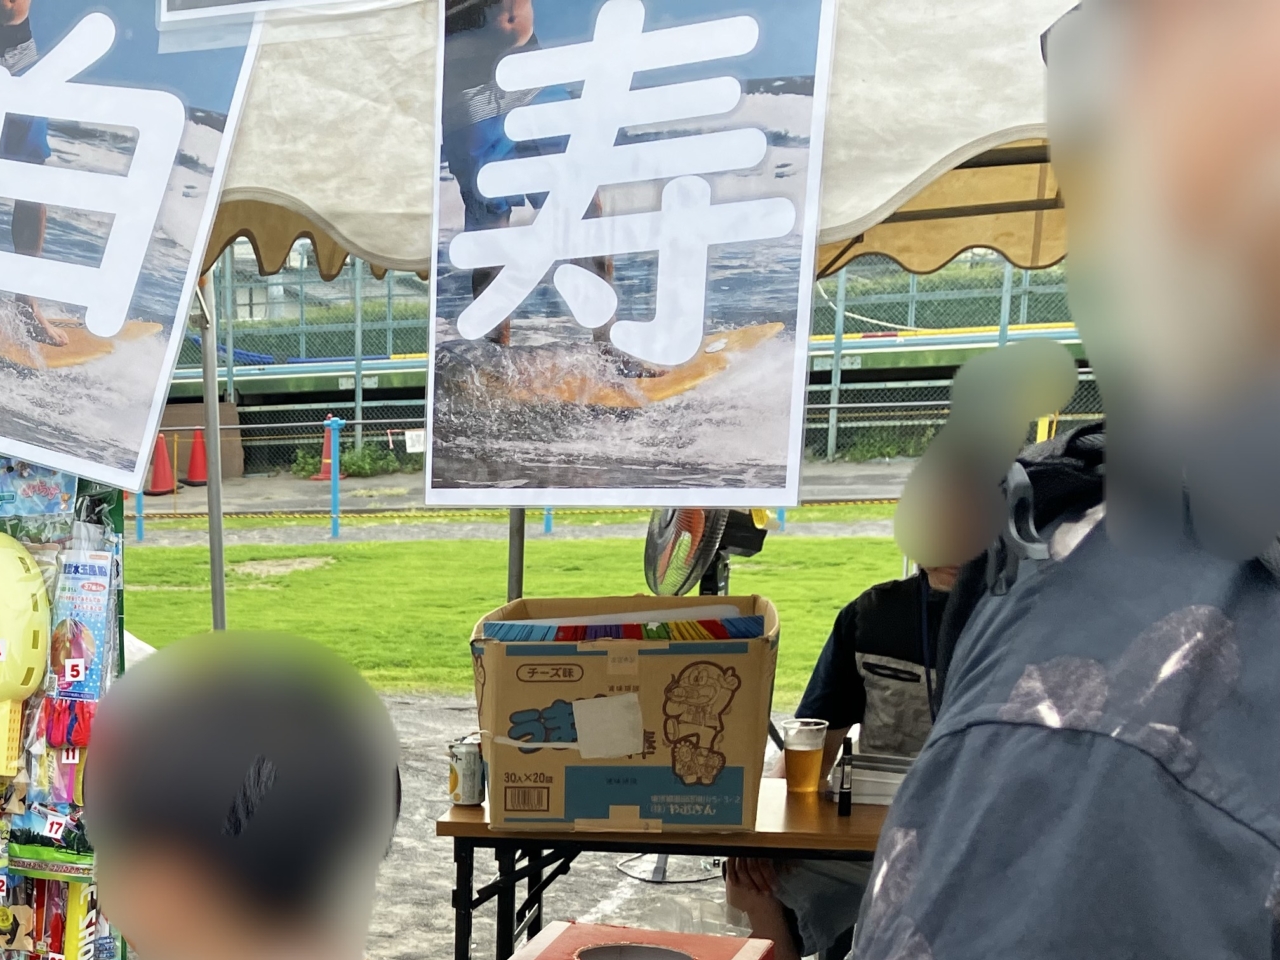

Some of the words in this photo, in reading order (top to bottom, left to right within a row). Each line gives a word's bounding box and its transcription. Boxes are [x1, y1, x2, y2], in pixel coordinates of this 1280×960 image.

[449, 0, 797, 366] 寿
[70, 664, 81, 678] 5
[527, 667, 574, 679] チーズ味
[64, 747, 76, 761] 11
[48, 820, 64, 835] 17
